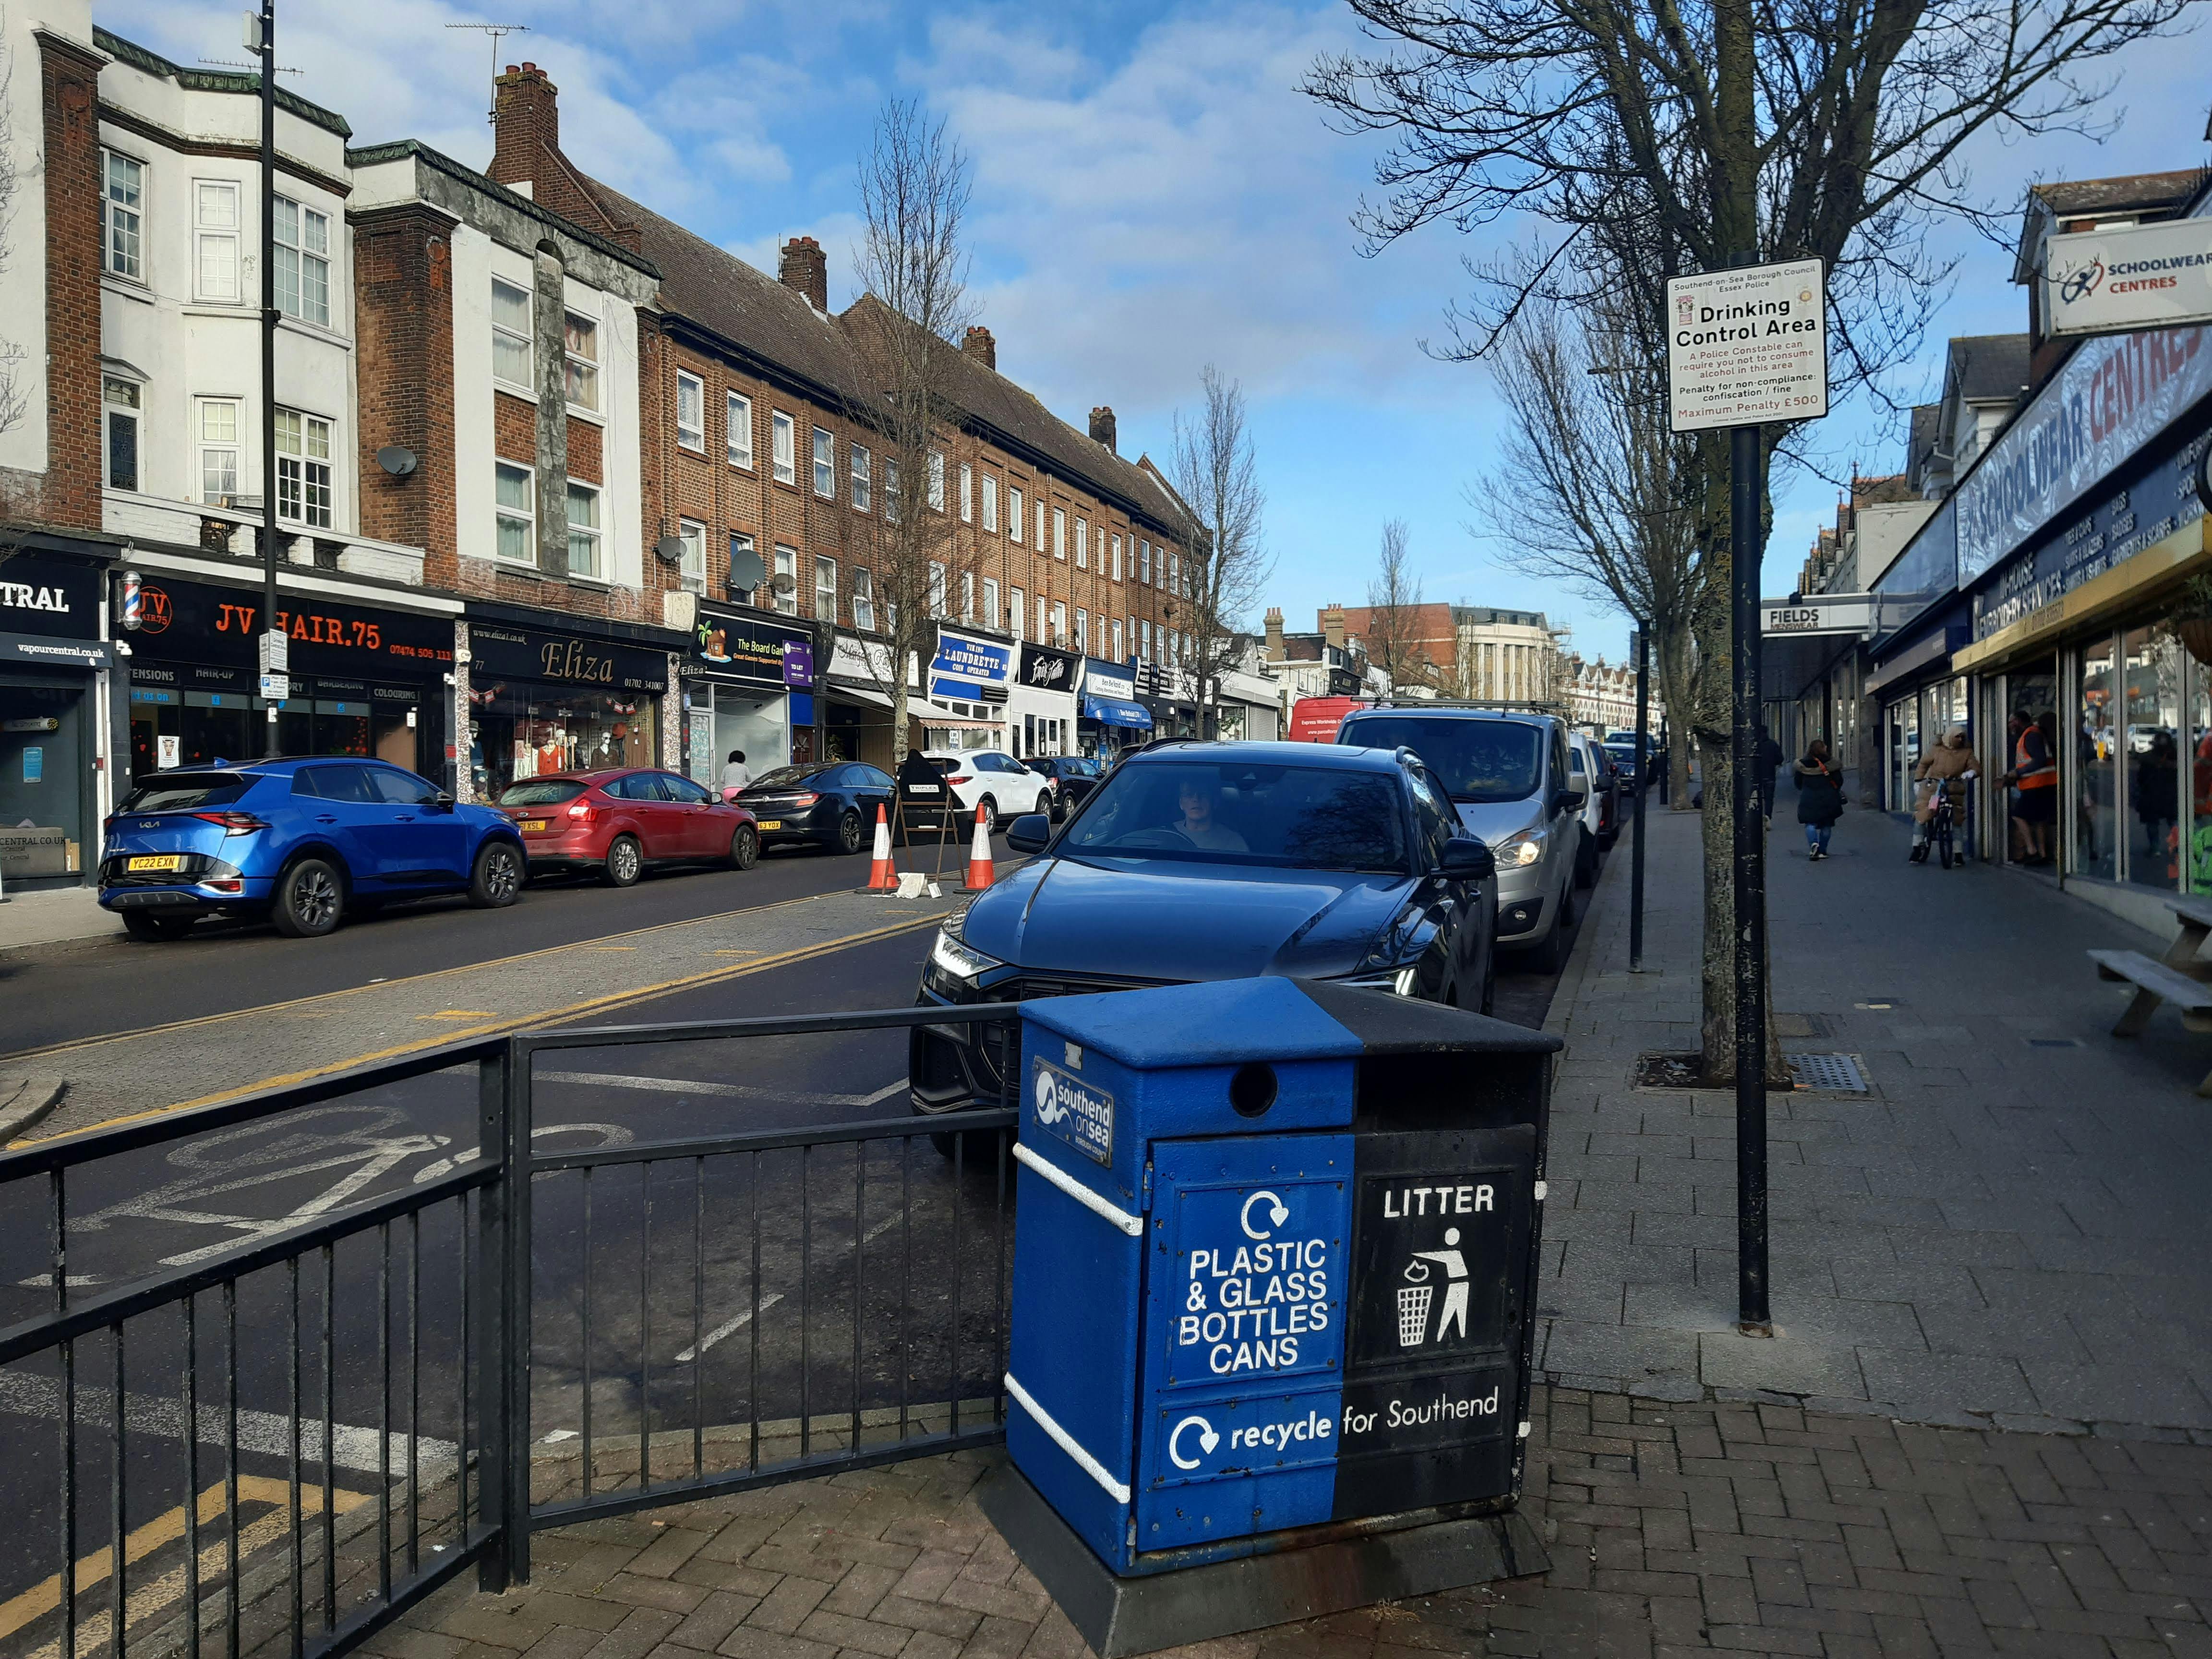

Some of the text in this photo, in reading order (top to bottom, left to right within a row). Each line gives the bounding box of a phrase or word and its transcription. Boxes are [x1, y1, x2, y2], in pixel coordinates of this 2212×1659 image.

[2108, 252, 2212, 276] SCHOOLWEAR
[1674, 265, 1816, 291] Southend-on-Sea Borough Council
[1745, 280, 1770, 289] Police
[2109, 275, 2178, 294] CENTRES
[1700, 300, 1790, 323] Drinking
[1676, 318, 1816, 347] Control Area
[1689, 341, 1803, 361] A Police Constable can
[1679, 349, 1814, 372] require you not to consume
[1699, 362, 1793, 379] alcohol in this area
[1679, 373, 1817, 395] Penalty for non-compliance:
[2090, 329, 2202, 443] CENTRES
[1703, 385, 1791, 402] confiscation / fine
[1678, 406, 1732, 419] Maximum
[1737, 399, 1780, 412] Penalty
[0, 581, 69, 613] TRAL
[138, 591, 168, 615] JV
[142, 613, 168, 625] AIR.75
[1770, 608, 1819, 624] FIELDS
[216, 603, 382, 649] JV HAIR.75
[1770, 622, 1819, 631] MENSWEAR
[472, 628, 528, 646] www.eliza1.co.uk
[737, 638, 750, 651] The
[751, 640, 770, 654] Board
[17, 644, 105, 659] vapourcentral.co.uk
[389, 644, 452, 661] 07474 505 111
[966, 643, 984, 654] VIKING
[475, 660, 485, 671] 77
[541, 639, 614, 684] Eliza
[758, 656, 778, 665] Supported
[944, 649, 999, 670] LAUNDRETTE
[195, 667, 235, 680] HAIR-UP
[952, 663, 990, 677] COIN OPERATED
[264, 678, 269, 686] P
[624, 677, 664, 691] 01702 341007
[157, 693, 169, 701] on
[373, 688, 416, 699] COLOURING
[527, 822, 541, 830] XSL
[133, 857, 175, 869] YC22 EXN
[1058, 1084, 1110, 1128] southend
[1075, 1135, 1093, 1151] BOROUGH
[1383, 1184, 1495, 1218] LITTER
[1189, 1237, 1326, 1280] PLASTIC
[1186, 1270, 1328, 1310] & GLASS
[1178, 1301, 1329, 1346] BOTTLES
[1209, 1336, 1299, 1374] CANS
[1231, 1385, 1499, 1453] recycle for Southend
